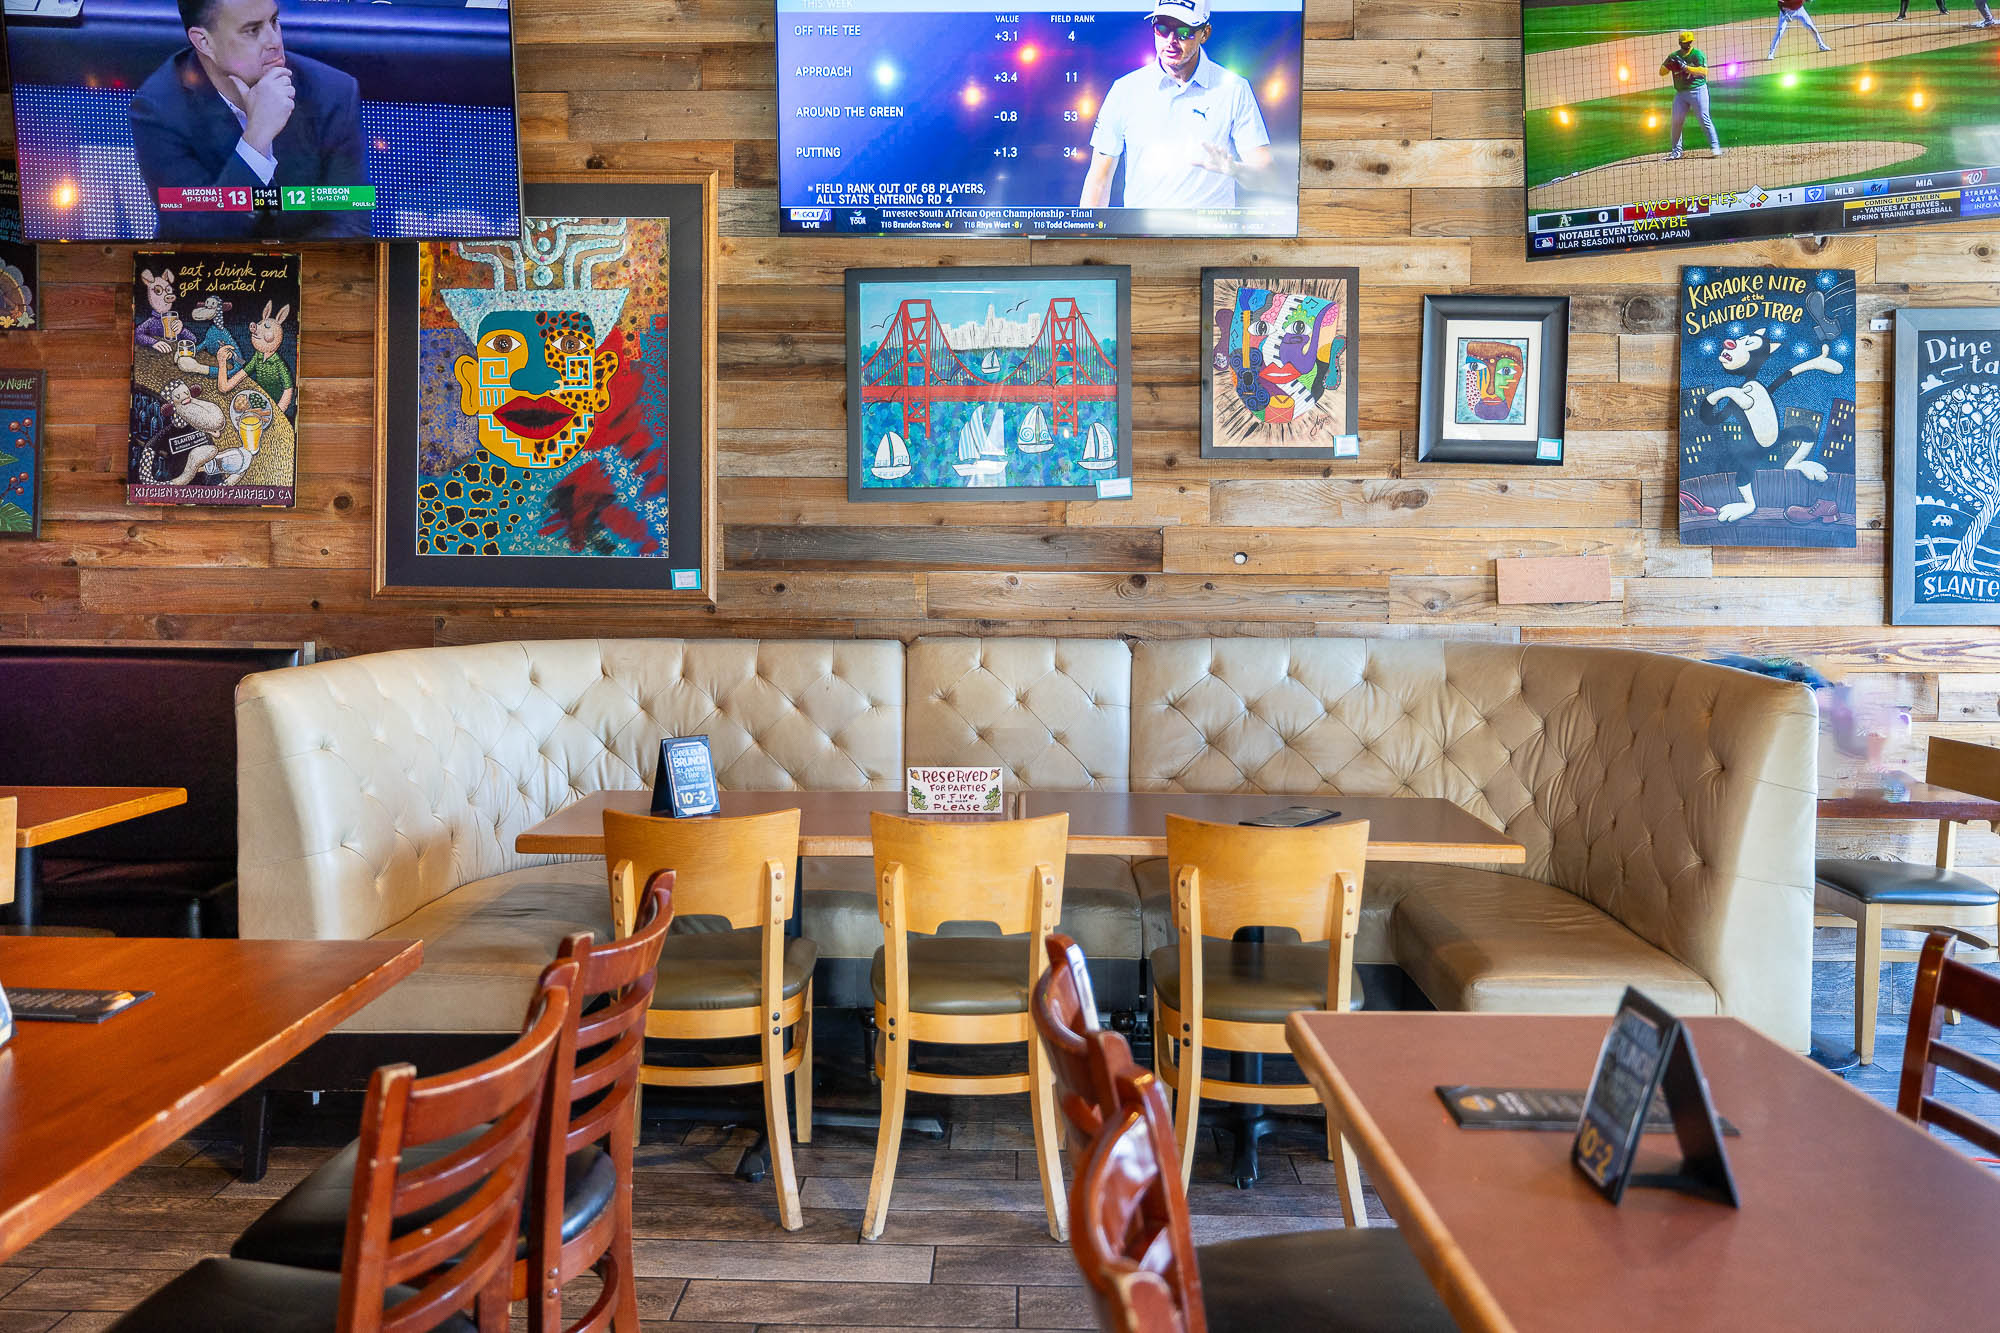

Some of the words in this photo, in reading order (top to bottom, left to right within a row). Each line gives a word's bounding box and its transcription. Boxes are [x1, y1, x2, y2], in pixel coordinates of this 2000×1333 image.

[995, 15, 1020, 23] VALUE
[1050, 15, 1071, 23] FIELD
[1074, 15, 1095, 23] RANK
[794, 25, 814, 36] OFF
[818, 25, 839, 36] THE
[842, 25, 861, 36] TEE
[994, 30, 1018, 42] +3.1
[1068, 30, 1076, 41] 4
[795, 66, 852, 77] APPROACH
[994, 71, 1018, 83] +3.4
[1065, 71, 1078, 83] 11
[795, 106, 841, 117] AROUND
[844, 106, 865, 117] THE
[869, 106, 904, 117] GREEN
[994, 111, 1018, 122] -0.8
[1063, 111, 1078, 122] 53
[796, 147, 841, 158] PUTTING
[993, 147, 1018, 158] +1.3
[1063, 147, 1078, 158] 34
[316, 187, 350, 195] OREGON
[815, 183, 843, 194] FIELD
[847, 183, 875, 194] RANK
[879, 183, 900, 194] OUT
[903, 183, 918, 194] OF
[921, 183, 935, 194] 68
[939, 183, 986, 195] PLAYERS,
[1834, 187, 1855, 196] MLB
[1916, 178, 1933, 188] MIA
[1965, 188, 1997, 197] STREAM
[228, 190, 247, 205] 13
[254, 189, 277, 198] 11:41
[287, 190, 306, 205] 12
[816, 194, 835, 205] ALL
[838, 194, 870, 205] STATS
[873, 194, 924, 205] ENTERING
[927, 194, 942, 205] RD
[945, 194, 953, 205] 4
[254, 198, 265, 206] 30
[267, 198, 278, 206] 1st
[1632, 199, 1670, 214] TWO
[1676, 191, 1742, 209] PITCHES.
[1864, 198, 1893, 207] COMING
[1919, 193, 1940, 201] MLBN
[1598, 211, 1609, 223] 0
[1687, 201, 1699, 213] 4
[1777, 192, 1793, 203] 1-1
[1864, 204, 1897, 214] YANKEES
[1910, 200, 1940, 209] BRAVES
[882, 209, 918, 218] Investec
[919, 209, 944, 218] South
[945, 209, 977, 218] African
[979, 209, 1001, 219] Open
[1003, 209, 1065, 219] Championship
[1071, 209, 1093, 218] Final
[1852, 212, 1879, 222] SPRING
[1880, 209, 1914, 219] TRAINING
[1915, 205, 1953, 215] BASEBALL
[893, 221, 921, 229] Brandon
[921, 221, 941, 229] Stone
[993, 221, 1011, 229] West
[1046, 221, 1063, 229] Todd
[1063, 221, 1095, 229] Clements
[1634, 215, 1688, 231] MAYBE
[1559, 229, 1601, 241] NOTABLE
[1581, 238, 1614, 247] SEASON
[1616, 236, 1625, 244] IN
[1660, 229, 1690, 240] JAPAN)
[214, 260, 256, 278] drink
[260, 264, 288, 279] and
[179, 278, 202, 297] get
[1741, 294, 1751, 303] at
[1751, 293, 1765, 301] the
[1924, 336, 1992, 364] Dine
[134, 487, 173, 499] KITCHEN
[179, 488, 225, 499] TAPROOM
[227, 489, 275, 500] FAIRFIELD
[278, 489, 292, 500] CA
[672, 755, 706, 768] BRUNCH
[930, 784, 946, 792] FOR
